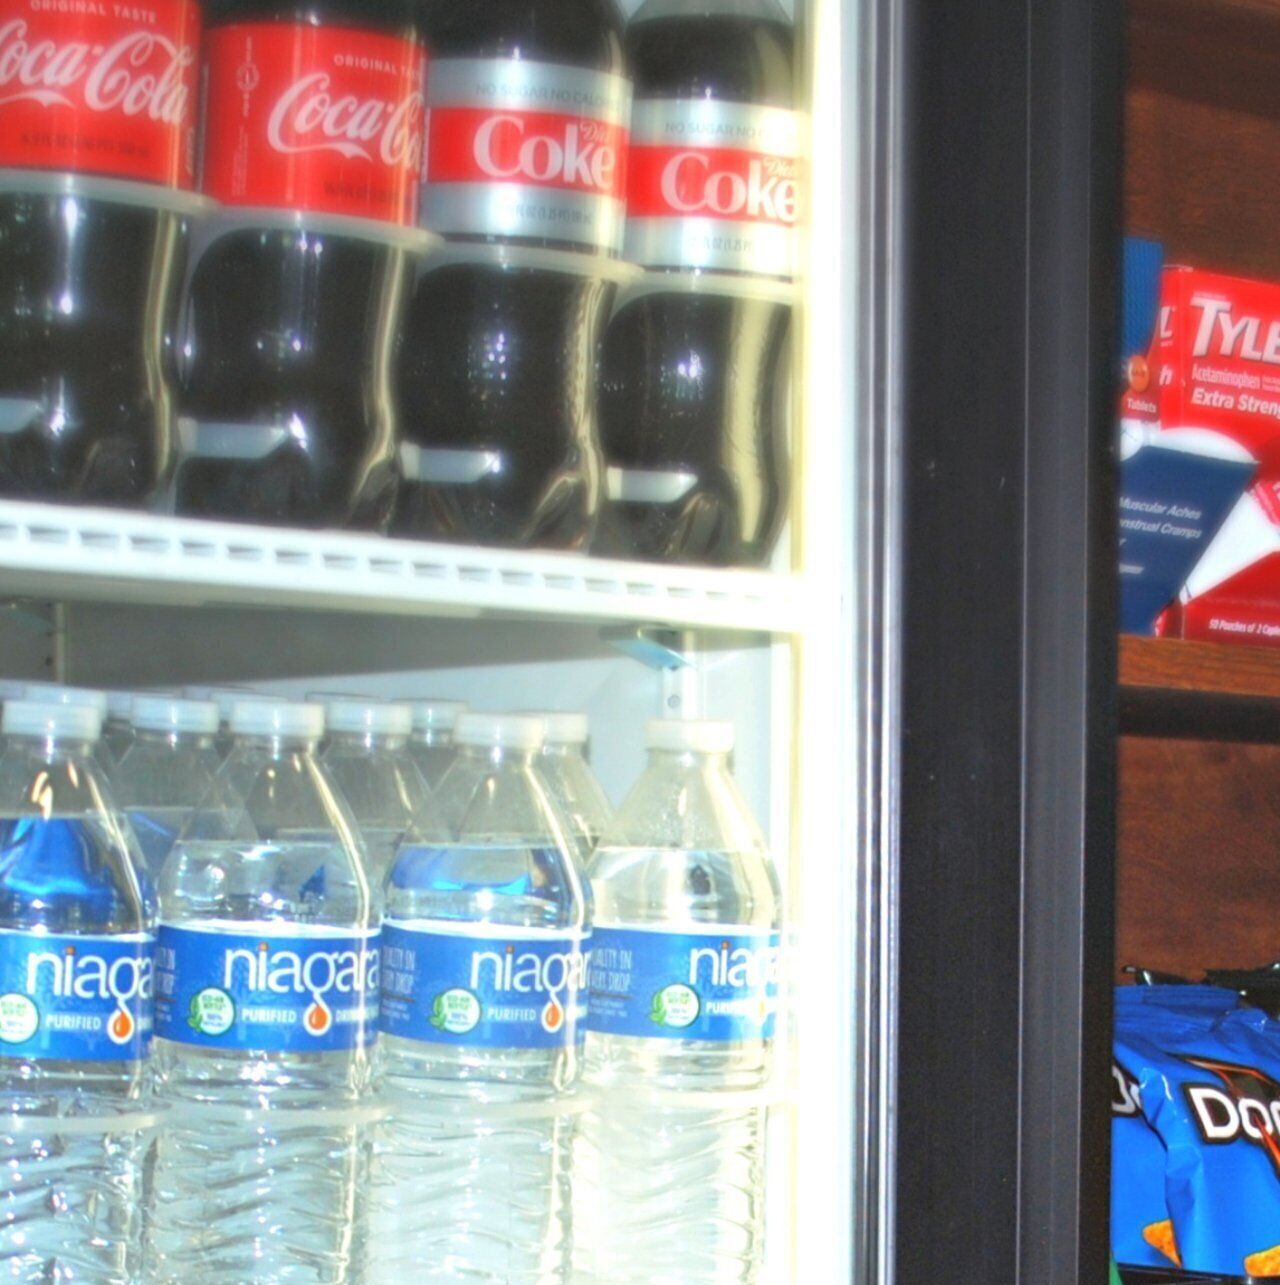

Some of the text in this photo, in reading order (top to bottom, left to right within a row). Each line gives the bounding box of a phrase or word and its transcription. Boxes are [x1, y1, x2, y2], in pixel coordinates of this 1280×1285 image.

[113, 5, 157, 24] TASTE
[334, 54, 398, 76] ORIGINAL
[473, 114, 616, 191] Coke
[660, 151, 801, 223] Coke
[1192, 363, 1261, 390] Acetaminophen
[1191, 388, 1234, 410] Extra
[1169, 504, 1202, 520] Aches
[1161, 523, 1202, 539] Cramps
[1220, 618, 1247, 632] Pouches
[1248, 623, 1256, 633] of
[45, 1013, 101, 1031] PURIFIED
[241, 1007, 297, 1024] PURIFIED
[487, 1007, 537, 1022] PURIFIED
